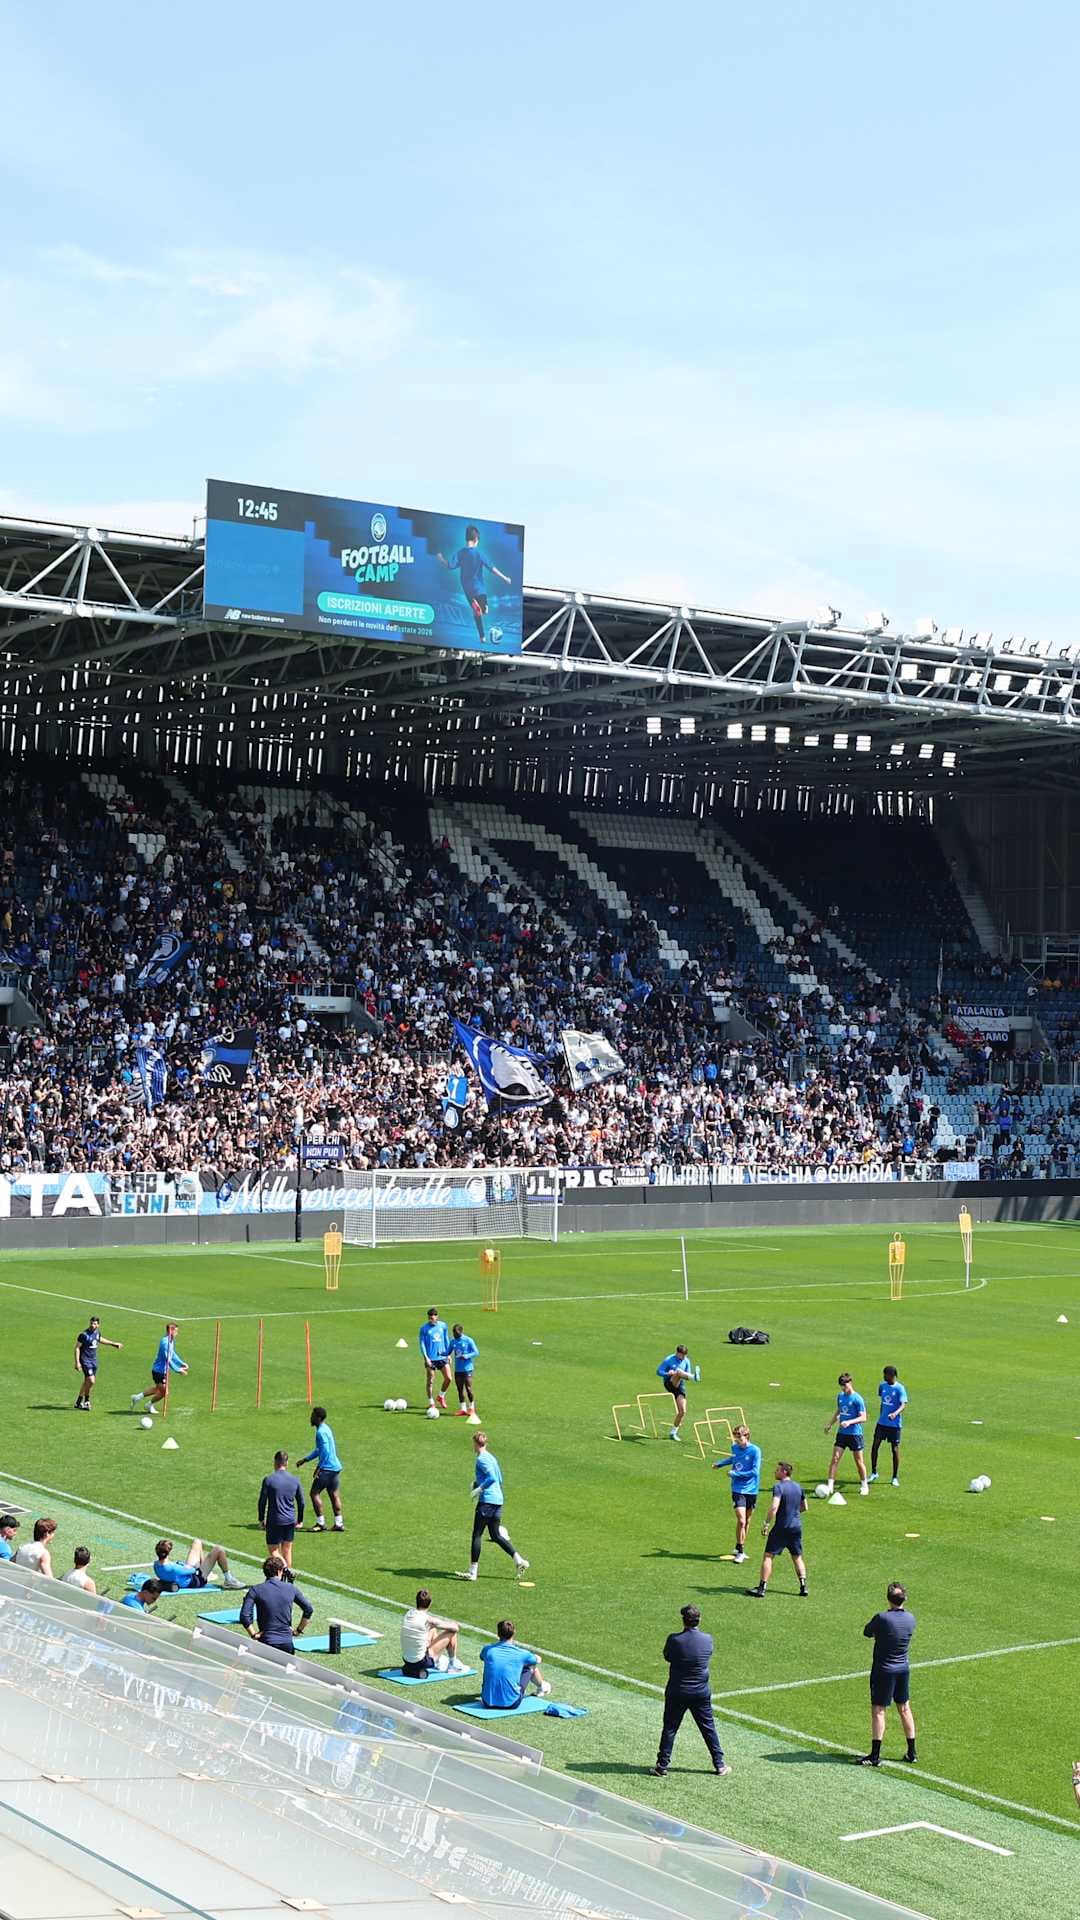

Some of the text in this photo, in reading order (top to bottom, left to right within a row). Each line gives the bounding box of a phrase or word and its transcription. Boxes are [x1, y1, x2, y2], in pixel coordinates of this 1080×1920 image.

[237, 498, 279, 521] 12:45
[341, 544, 415, 569] FOOTBALL
[355, 563, 399, 583] CAMP
[327, 597, 425, 619] ISCRIZIONI APERTE
[318, 616, 331, 625] Non
[956, 1006, 1005, 1017] ATALANTA
[306, 1136, 340, 1145] PER CHI
[306, 1147, 322, 1157] NON
[525, 1169, 614, 1196] ULTRAS
[749, 1165, 812, 1184] VECCHIA
[828, 1163, 893, 1183] GUARDIA
